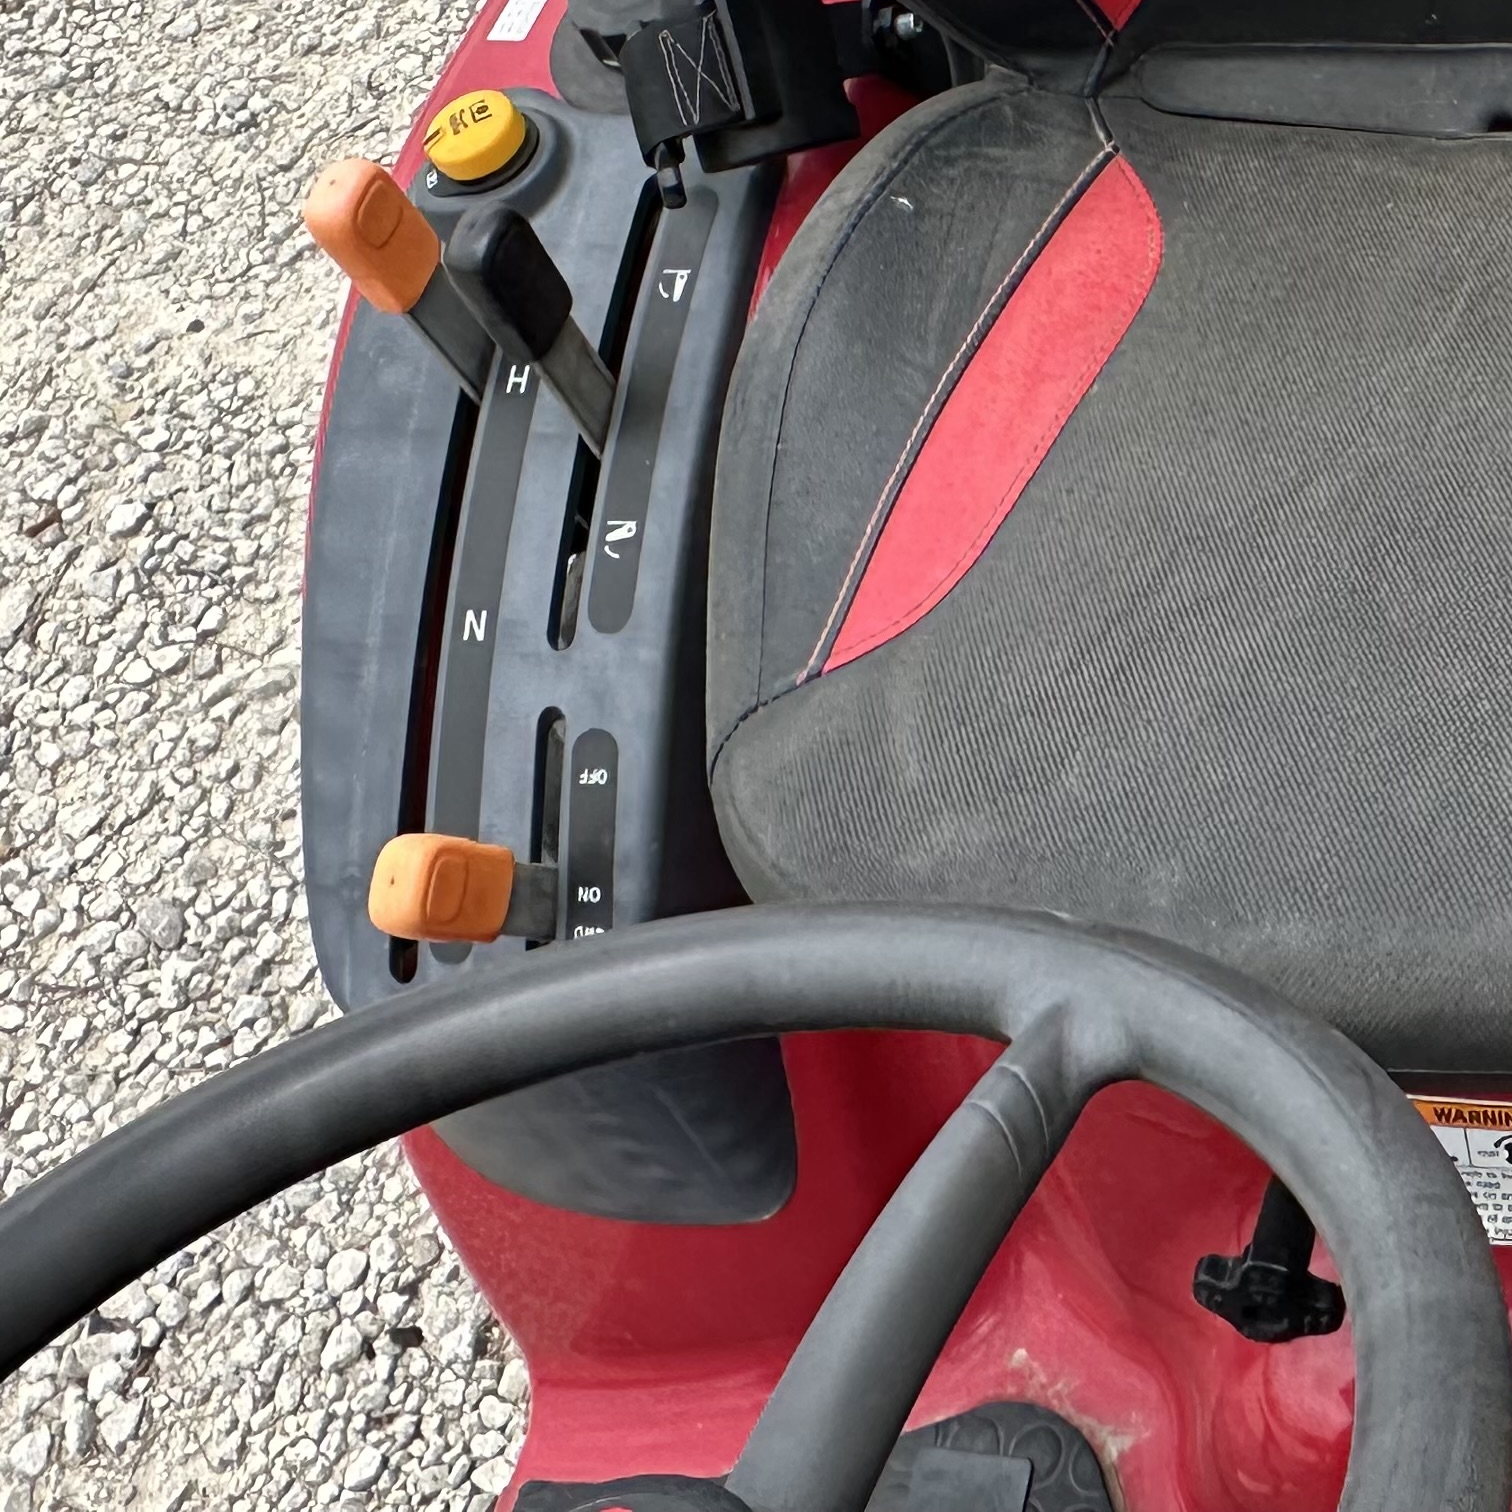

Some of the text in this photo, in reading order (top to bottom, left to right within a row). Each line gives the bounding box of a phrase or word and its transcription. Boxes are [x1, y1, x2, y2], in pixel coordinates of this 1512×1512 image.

[505, 364, 531, 395] H
[462, 609, 488, 642] N
[578, 768, 608, 786] OFF
[577, 886, 602, 904] ON
